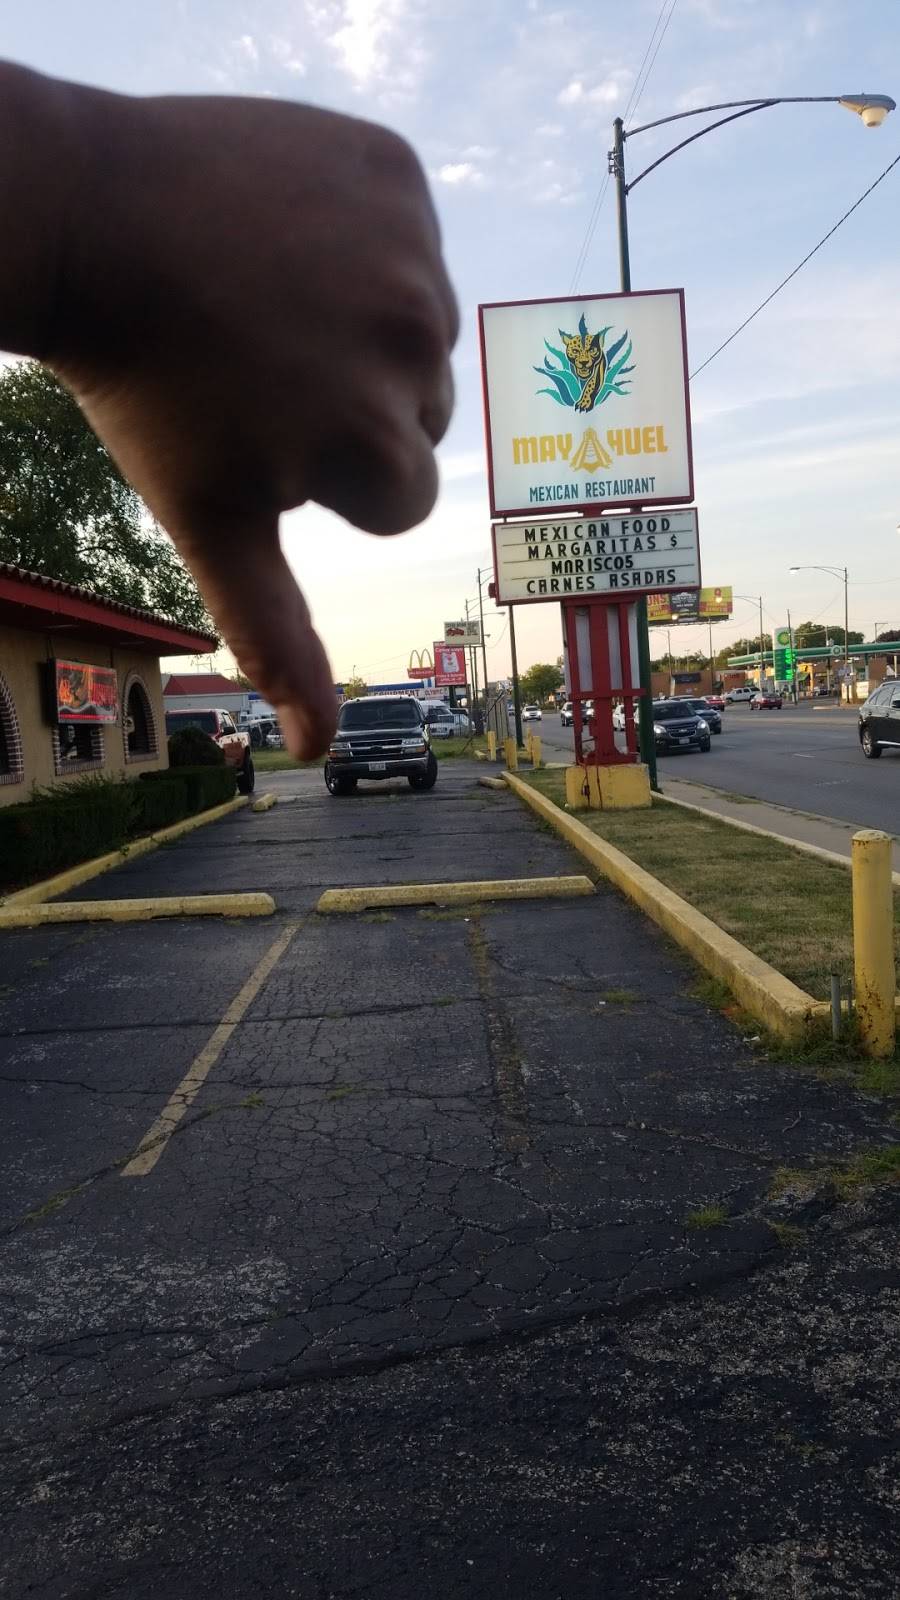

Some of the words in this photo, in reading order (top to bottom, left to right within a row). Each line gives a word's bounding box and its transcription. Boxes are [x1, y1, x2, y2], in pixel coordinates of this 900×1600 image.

[529, 483, 579, 503] MEXICAN
[585, 476, 656, 498] RESTAURANT
[524, 522, 610, 543] MEXICAN
[621, 517, 671, 535] FOOD
[528, 535, 656, 560] MARGARITAS
[526, 575, 595, 594] CARNES
[609, 568, 676, 588] ASADAS
